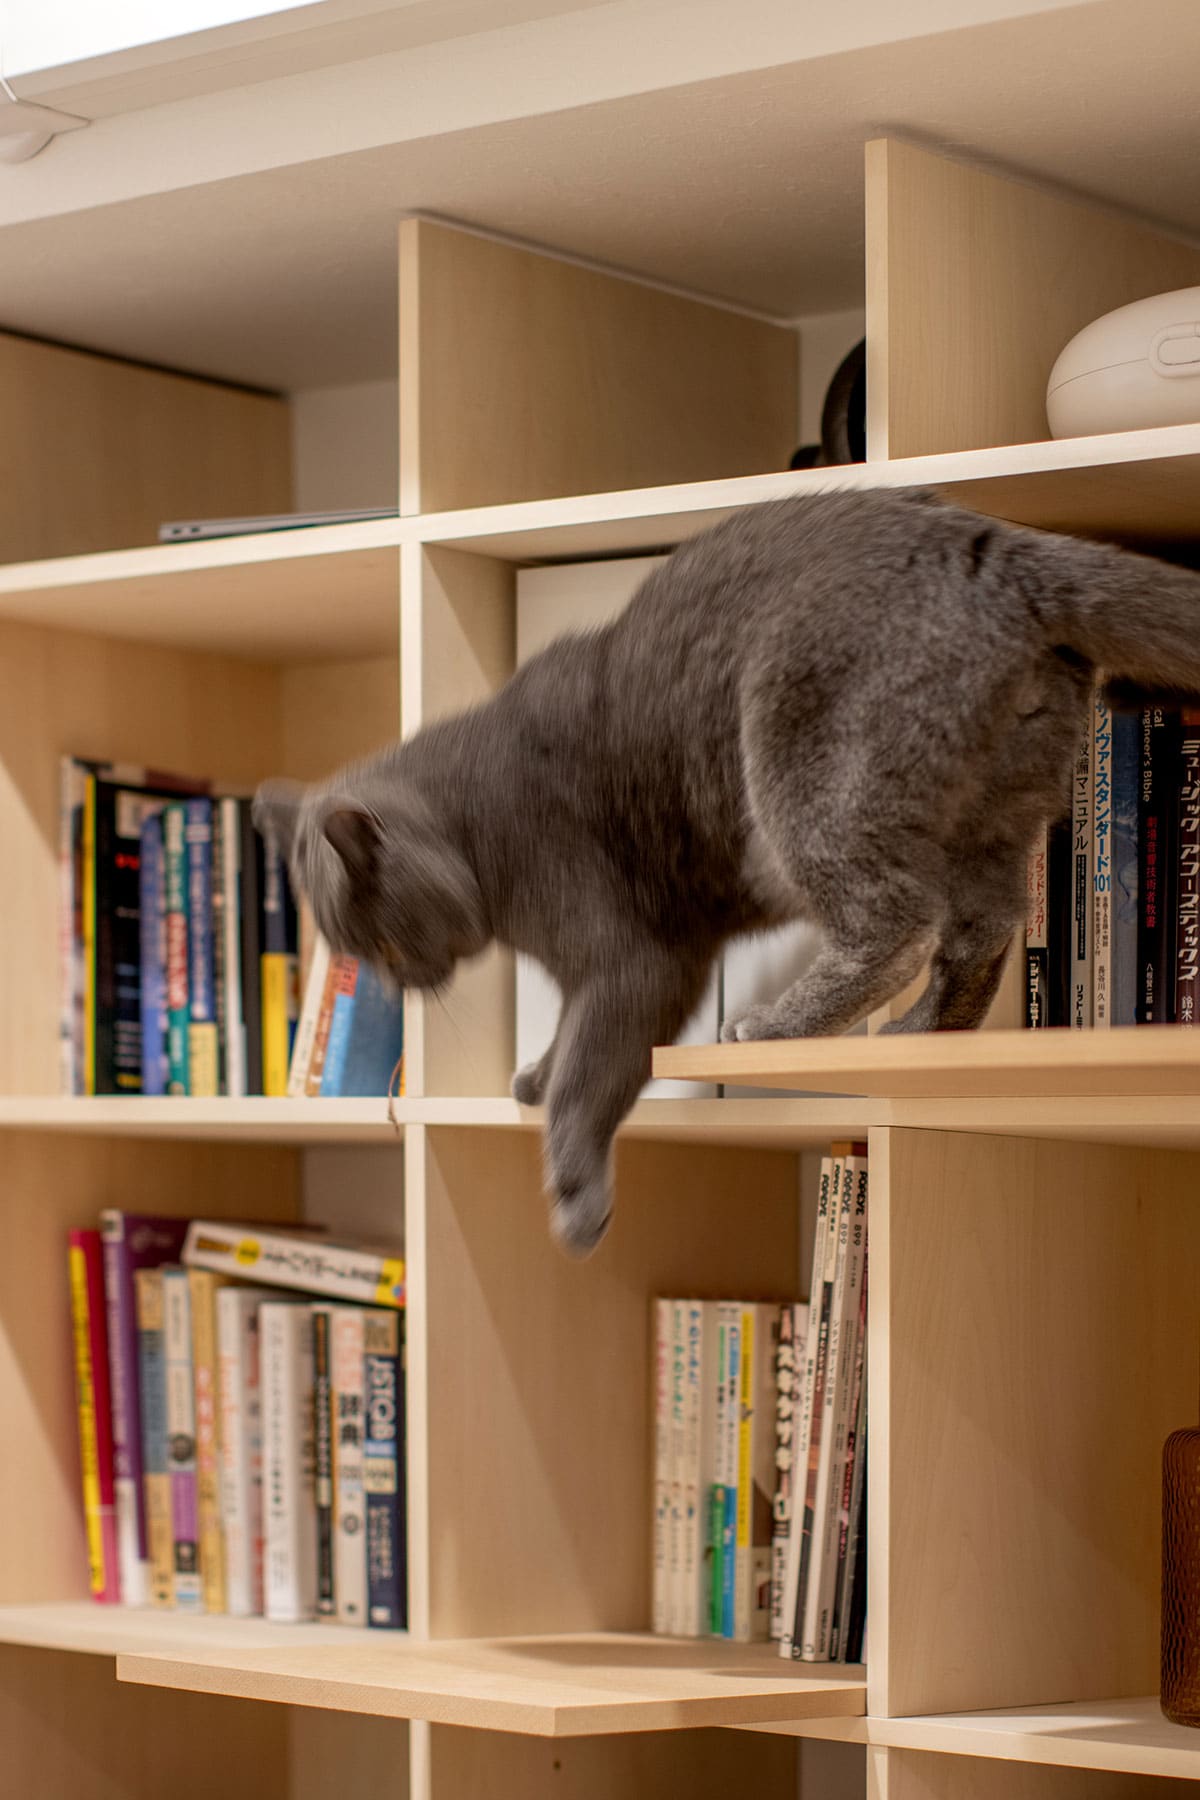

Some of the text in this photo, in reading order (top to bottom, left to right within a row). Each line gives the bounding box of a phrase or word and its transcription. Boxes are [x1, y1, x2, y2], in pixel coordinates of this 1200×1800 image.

[1142, 705, 1153, 802] ngineer's Bible
[1178, 738, 1200, 981] ミュージック アコースティックス
[819, 1174, 830, 1217] POPEYE
[832, 1164, 841, 1196] POPEYE
[842, 1169, 854, 1214] POPEYE
[853, 1170, 868, 1246] POPEYE 899
